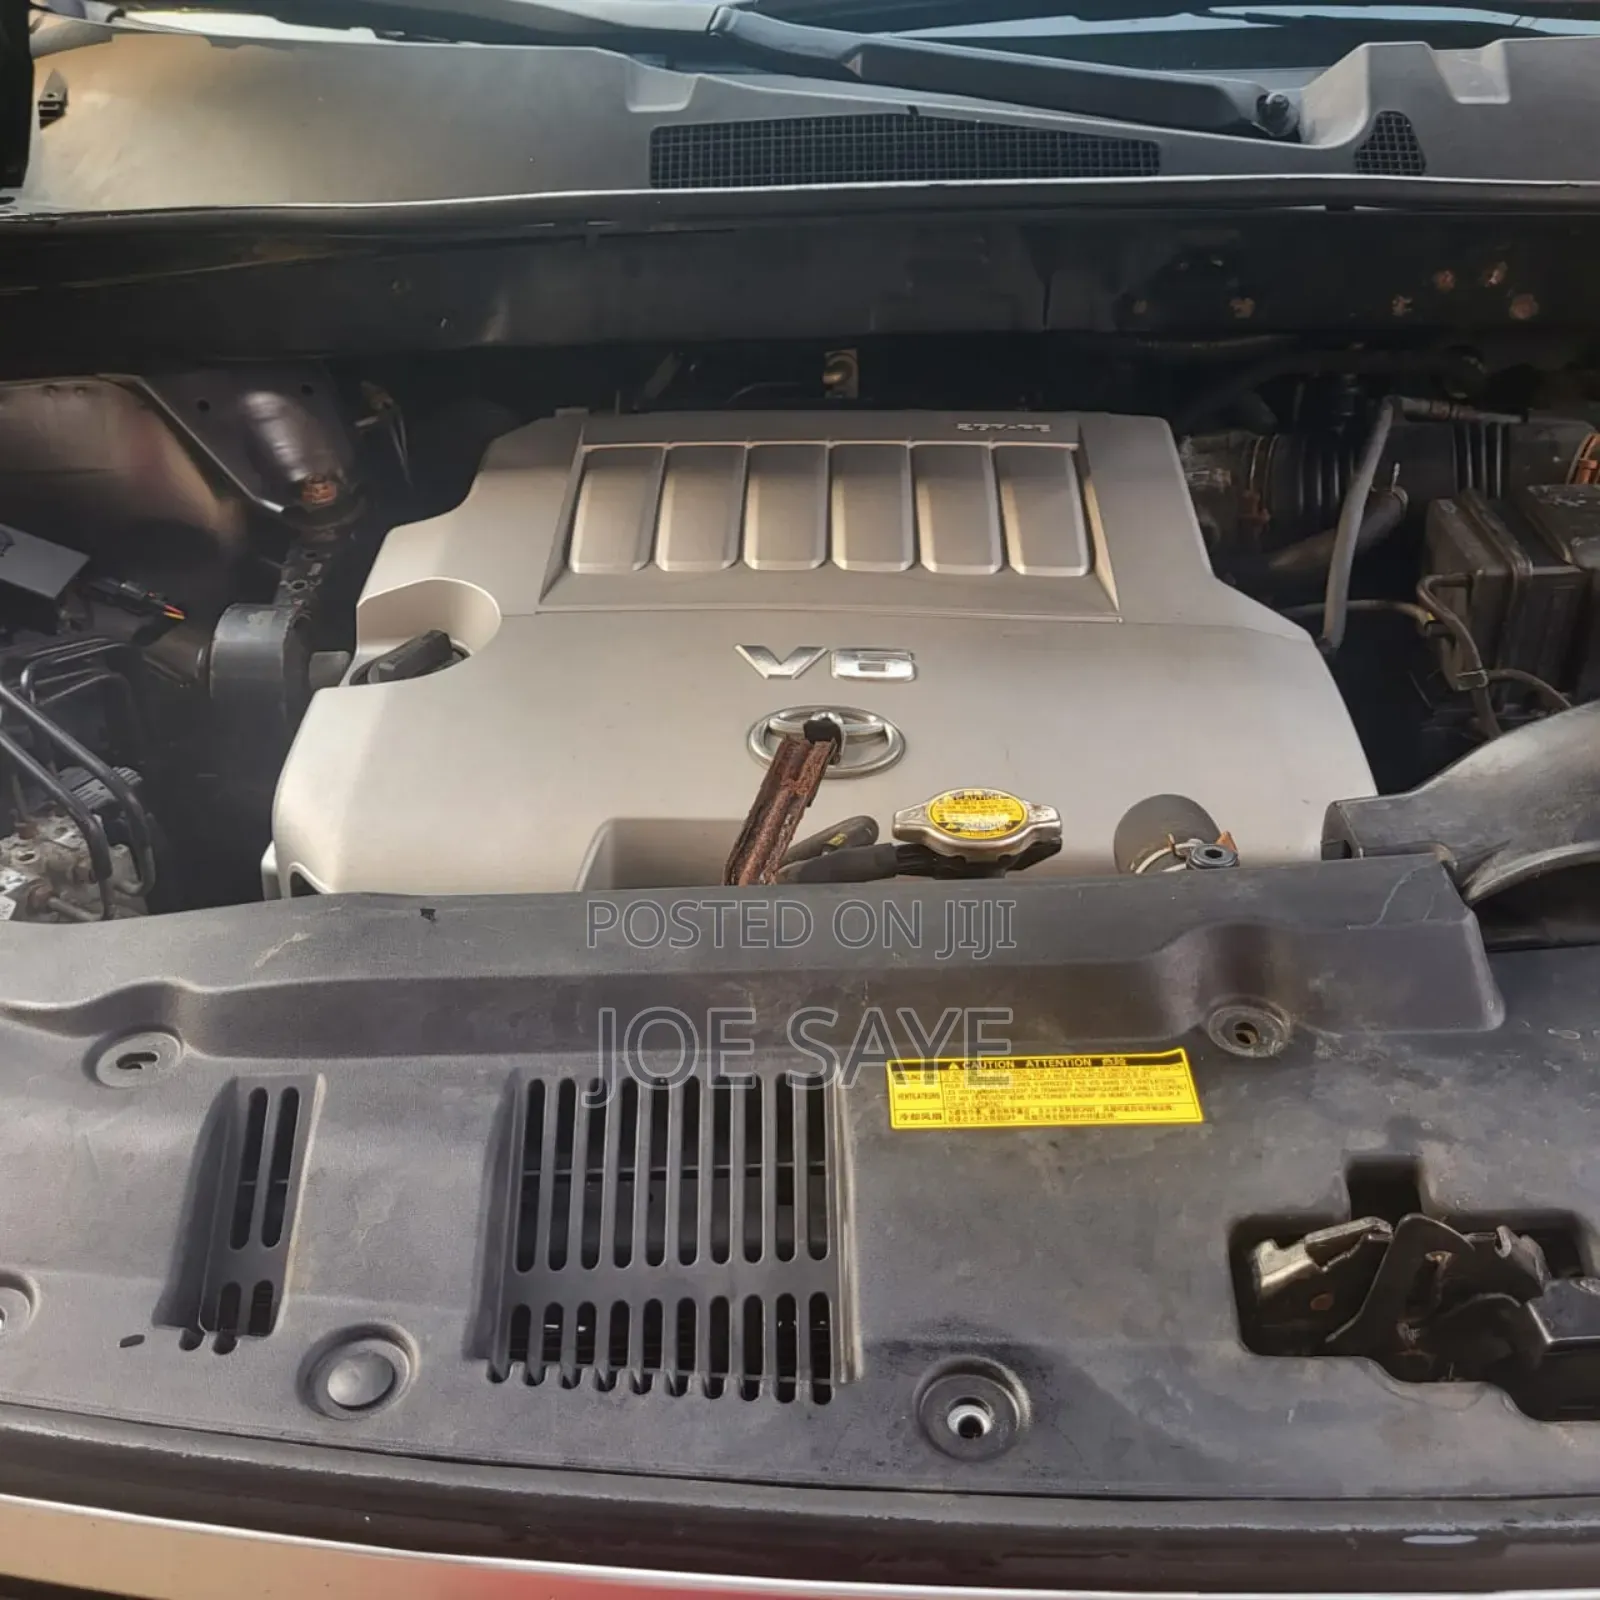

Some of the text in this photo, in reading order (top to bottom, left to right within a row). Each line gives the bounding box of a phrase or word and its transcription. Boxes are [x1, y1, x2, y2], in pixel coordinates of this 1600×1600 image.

[734, 643, 916, 683] V6
[962, 1058, 1015, 1069] CAUTION
[1025, 1057, 1092, 1068] ATTENTION
